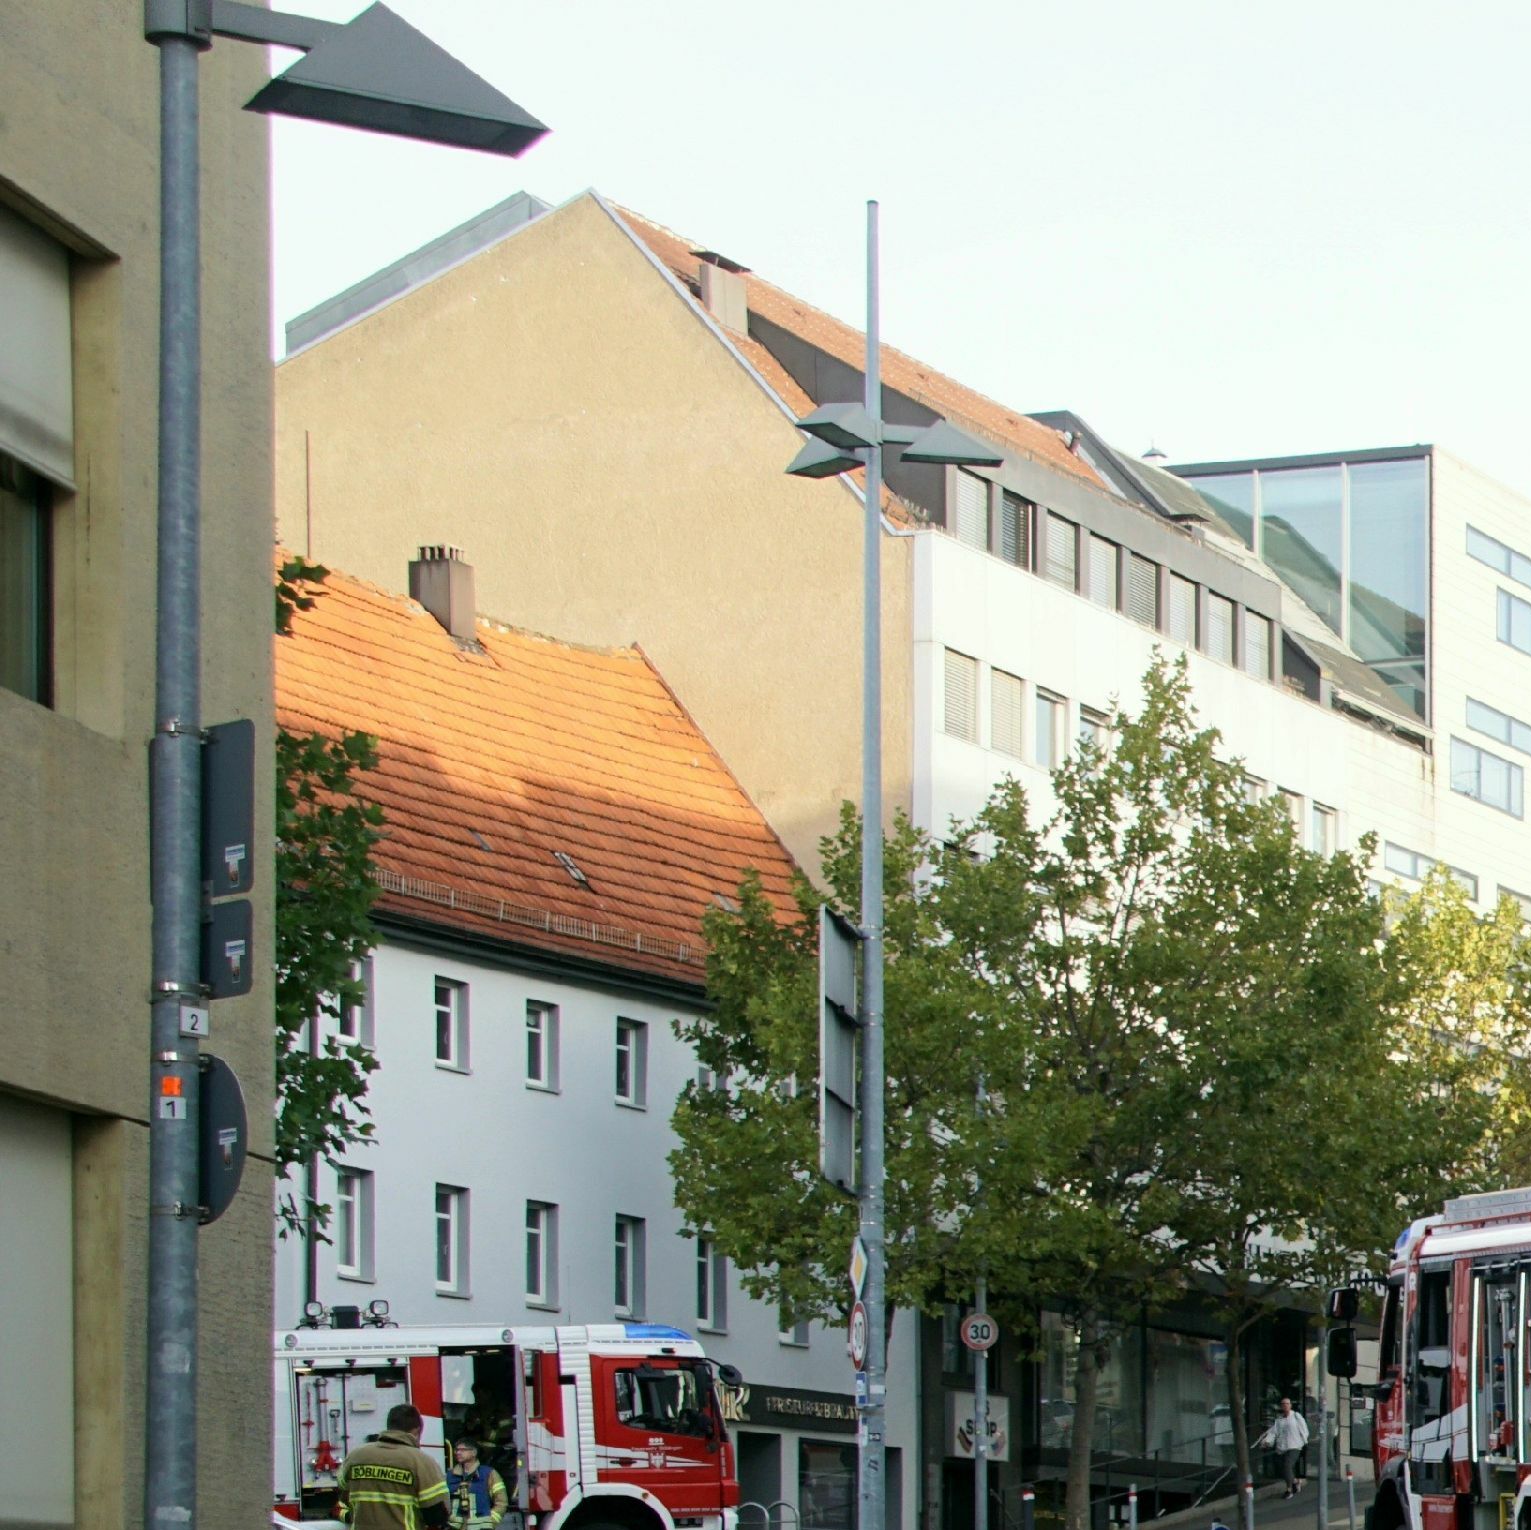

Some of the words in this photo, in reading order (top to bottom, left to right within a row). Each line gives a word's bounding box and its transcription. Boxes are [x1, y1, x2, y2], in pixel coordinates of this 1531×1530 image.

[190, 1014, 199, 1031] 2
[166, 1101, 176, 1118] 1
[970, 1324, 991, 1340] 30
[353, 1467, 410, 1482] BÖBLINGEN
